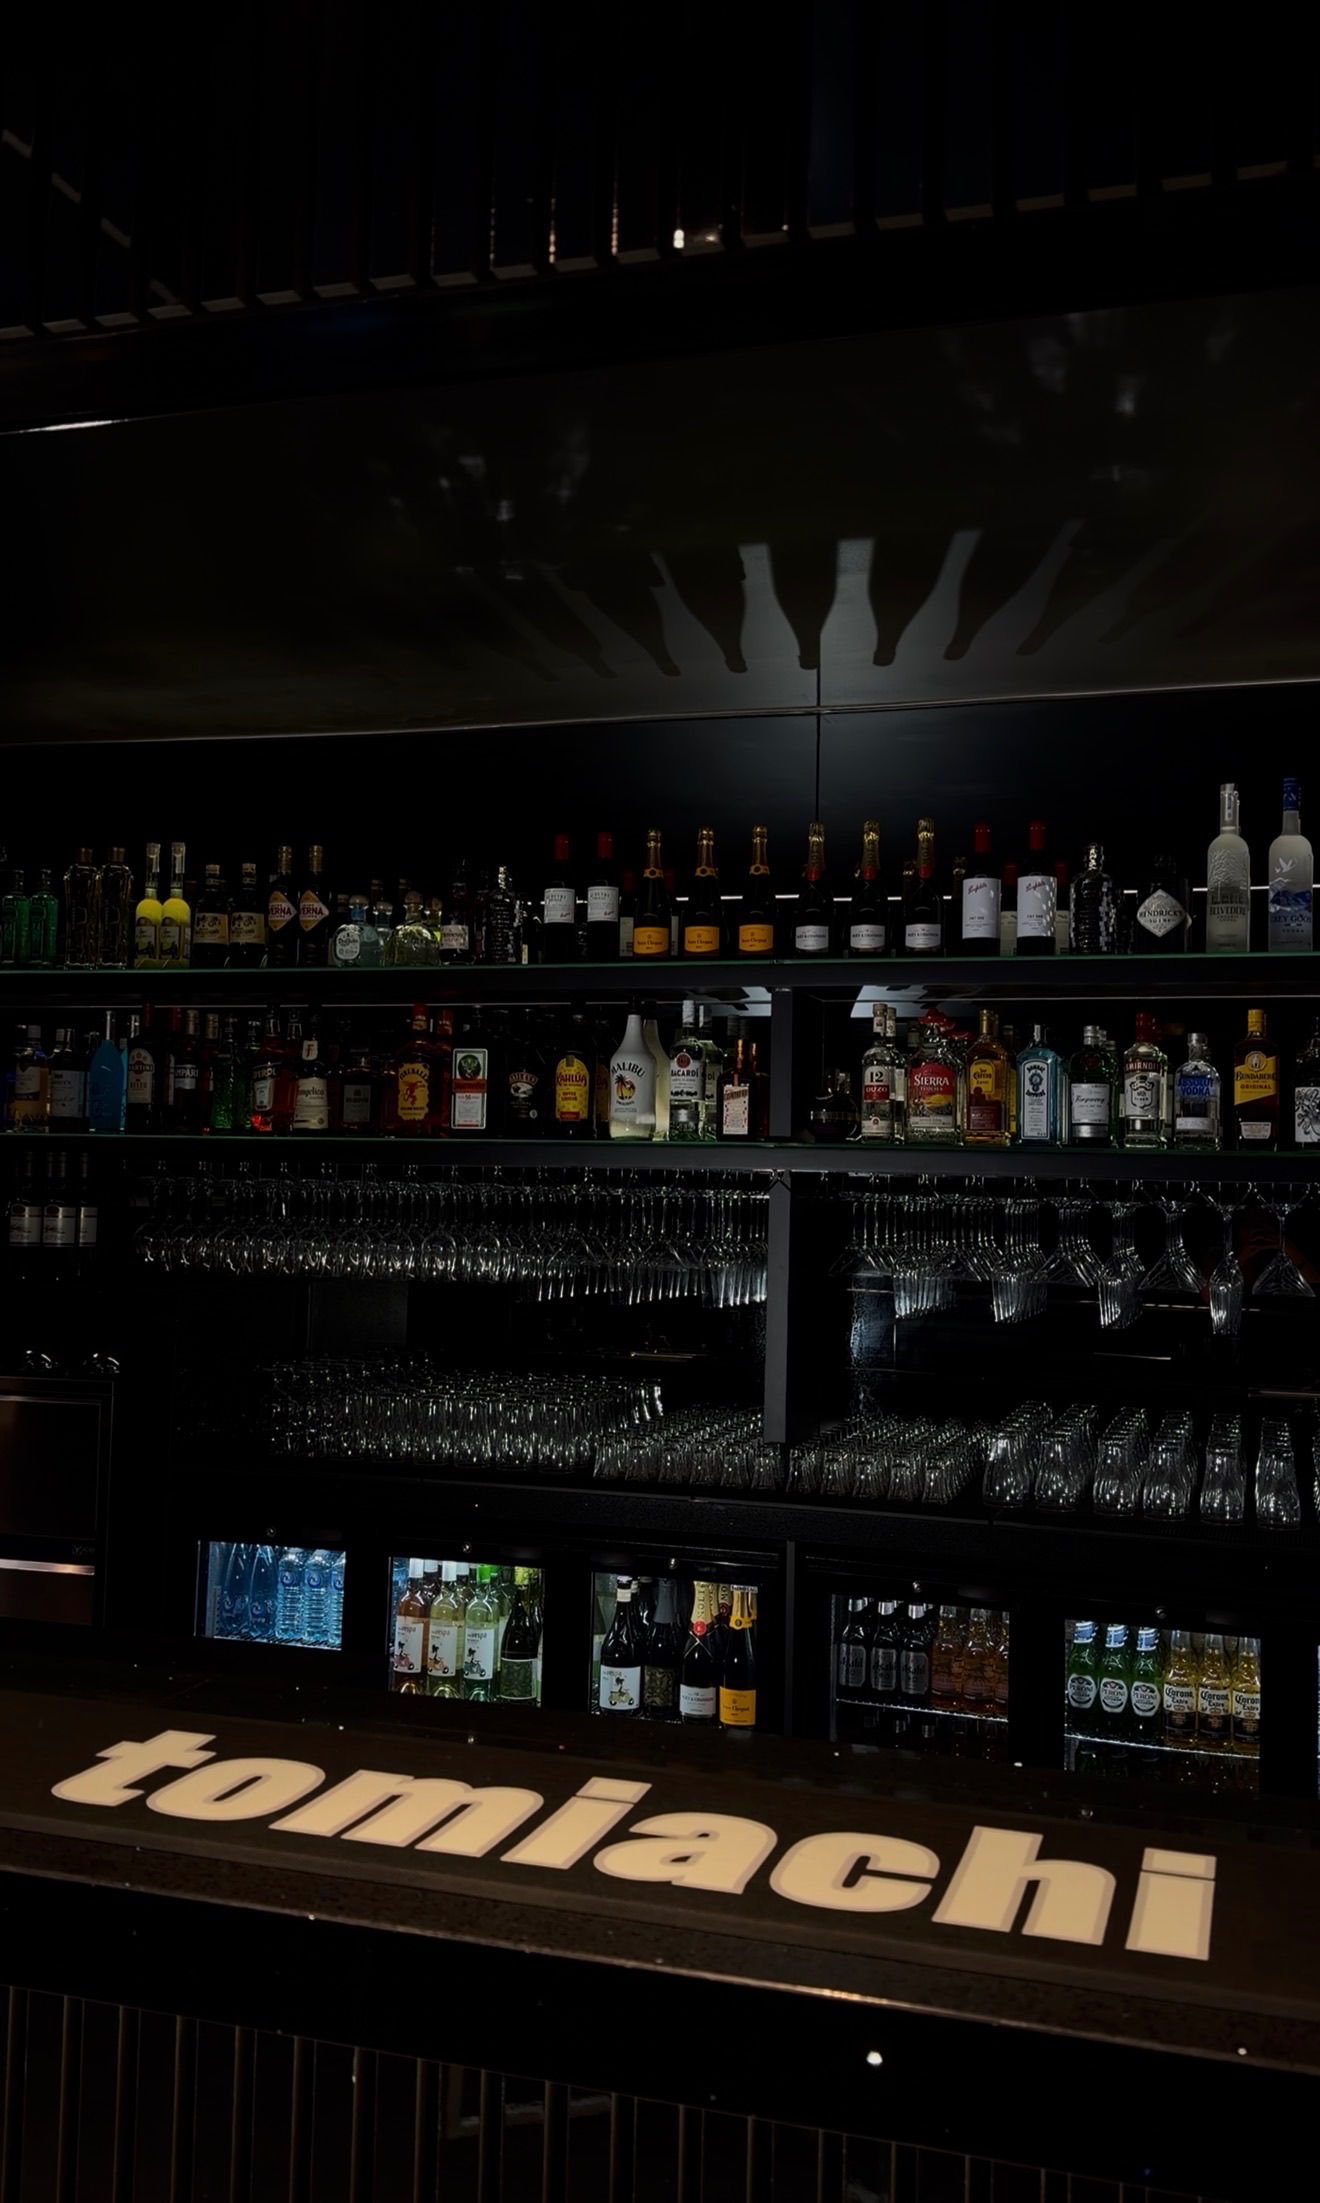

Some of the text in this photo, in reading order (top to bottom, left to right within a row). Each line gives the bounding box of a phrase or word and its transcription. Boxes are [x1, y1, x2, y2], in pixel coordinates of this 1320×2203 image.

[611, 1062, 646, 1078] MALIBU
[1125, 1060, 1160, 1071] SMIRNOFF
[671, 1068, 699, 1077] BACARDÍ
[870, 1071, 884, 1083] 12
[557, 1072, 587, 1087] KAHLÚA
[914, 1073, 950, 1086] SIERRA
[1177, 1077, 1214, 1087] ABSOLUT
[1181, 1086, 1211, 1096] VODKA
[1165, 1686, 1193, 1699] Corona
[1200, 1689, 1229, 1701] Corona
[1235, 1693, 1260, 1704] Coron
[52, 1731, 1215, 1960] tomiachi
